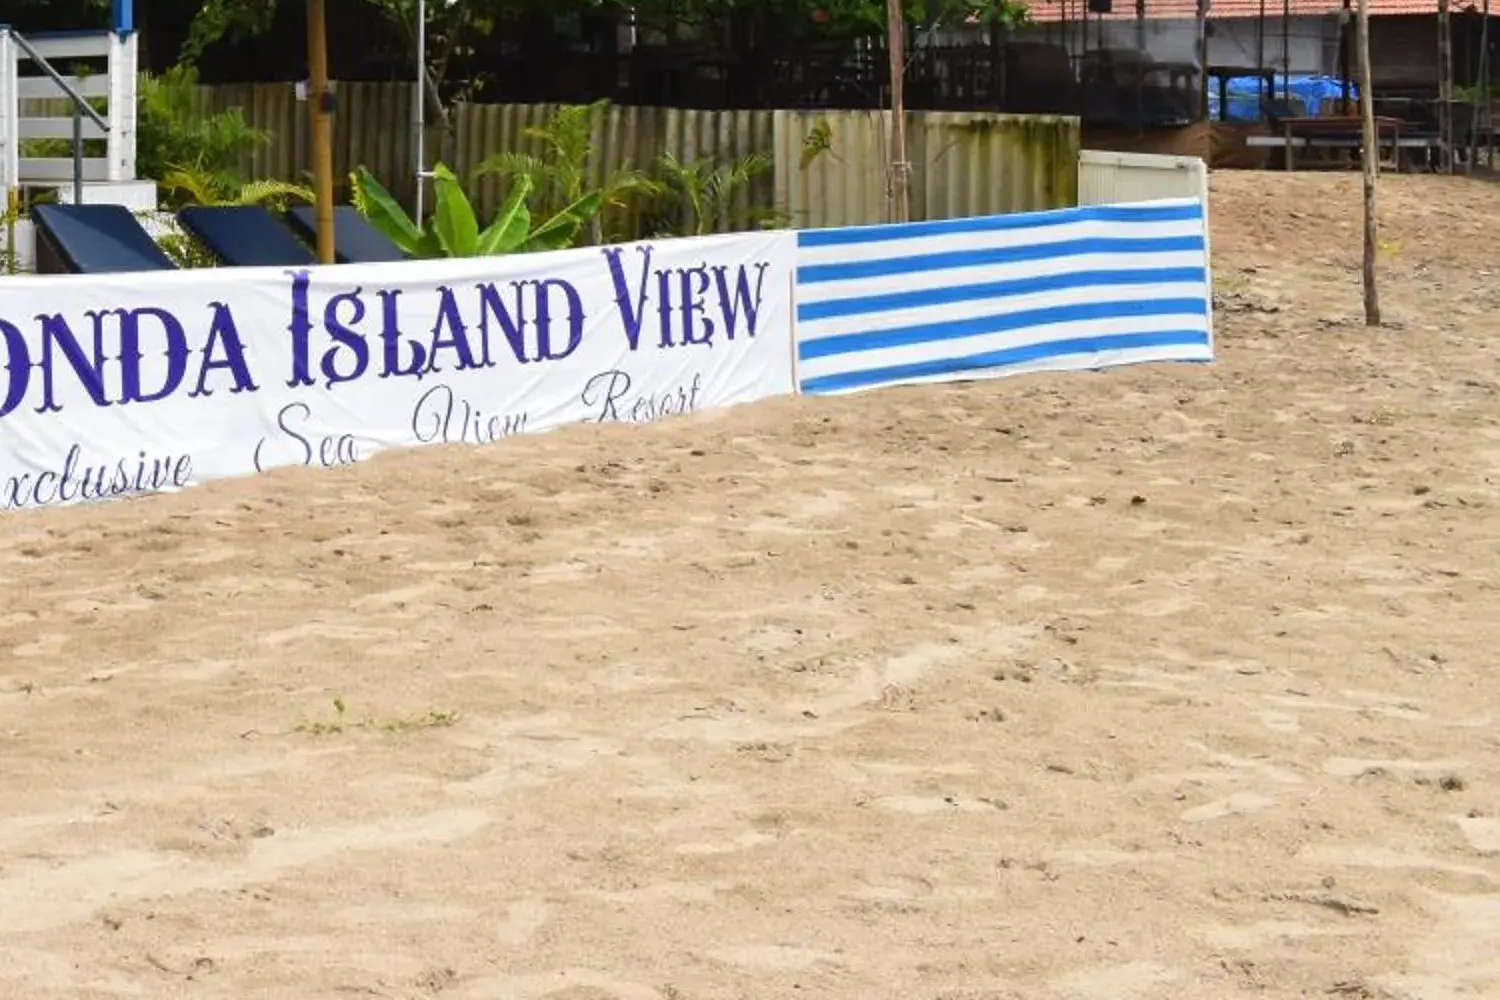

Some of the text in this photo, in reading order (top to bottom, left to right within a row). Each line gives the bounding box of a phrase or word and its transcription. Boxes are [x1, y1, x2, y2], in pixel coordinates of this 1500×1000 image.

[283, 269, 585, 391] ISLAND
[602, 245, 769, 352] VIEW
[254, 401, 359, 472] Sea
[412, 384, 528, 445] View
[580, 369, 701, 423] Resort
